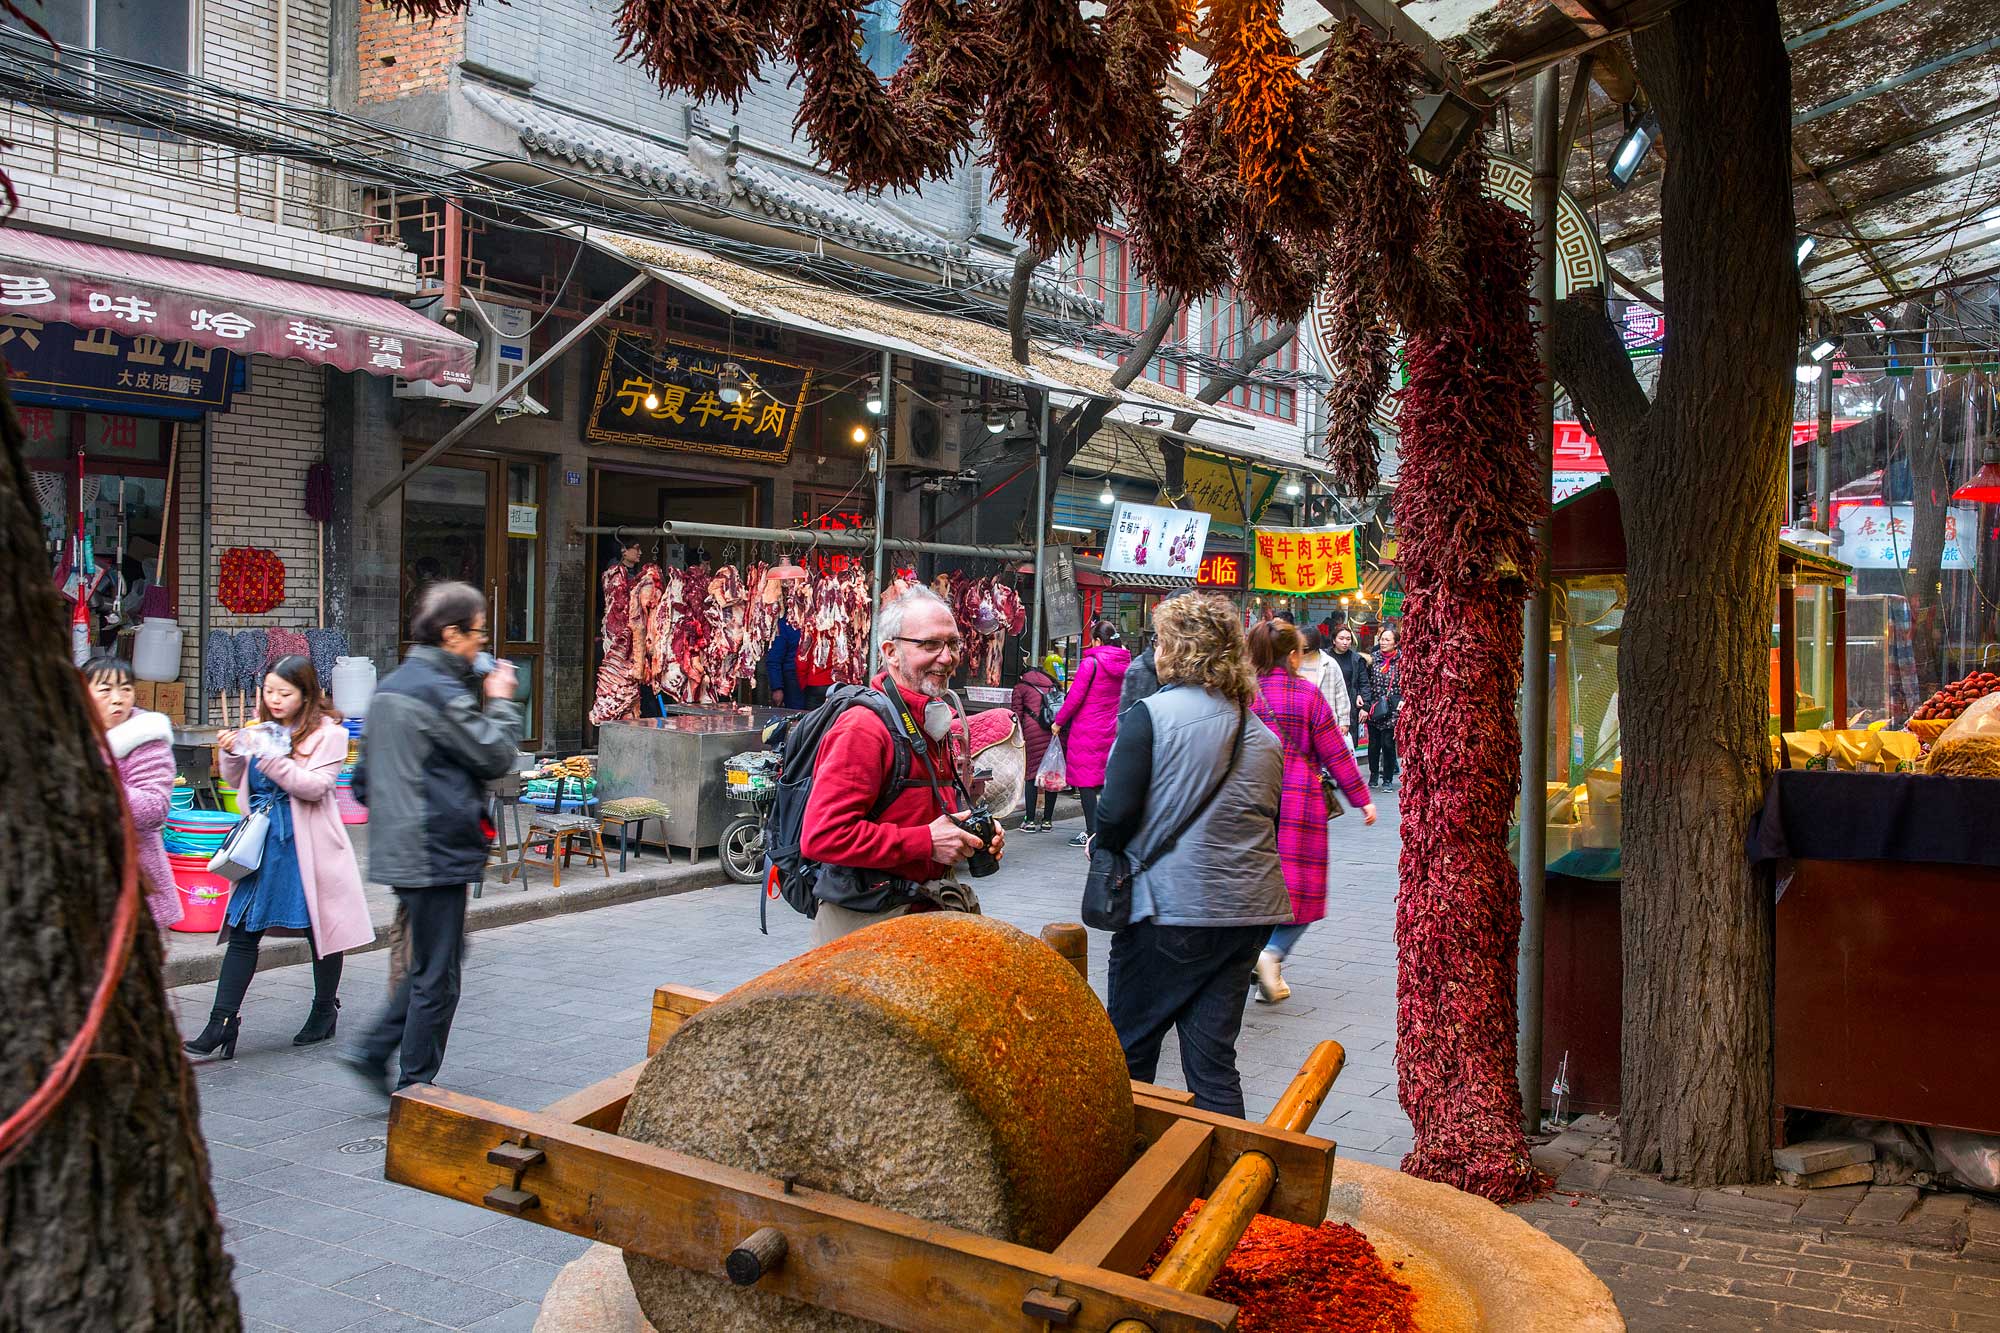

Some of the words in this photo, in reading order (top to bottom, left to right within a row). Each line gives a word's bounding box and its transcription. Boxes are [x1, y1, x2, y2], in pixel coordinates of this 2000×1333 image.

[616, 375, 787, 438] 宁夏牛羊肉
[510, 508, 533, 523] 招工
[1258, 533, 1351, 561] 腊牛肉夹馍
[901, 712, 917, 734] Nikon
